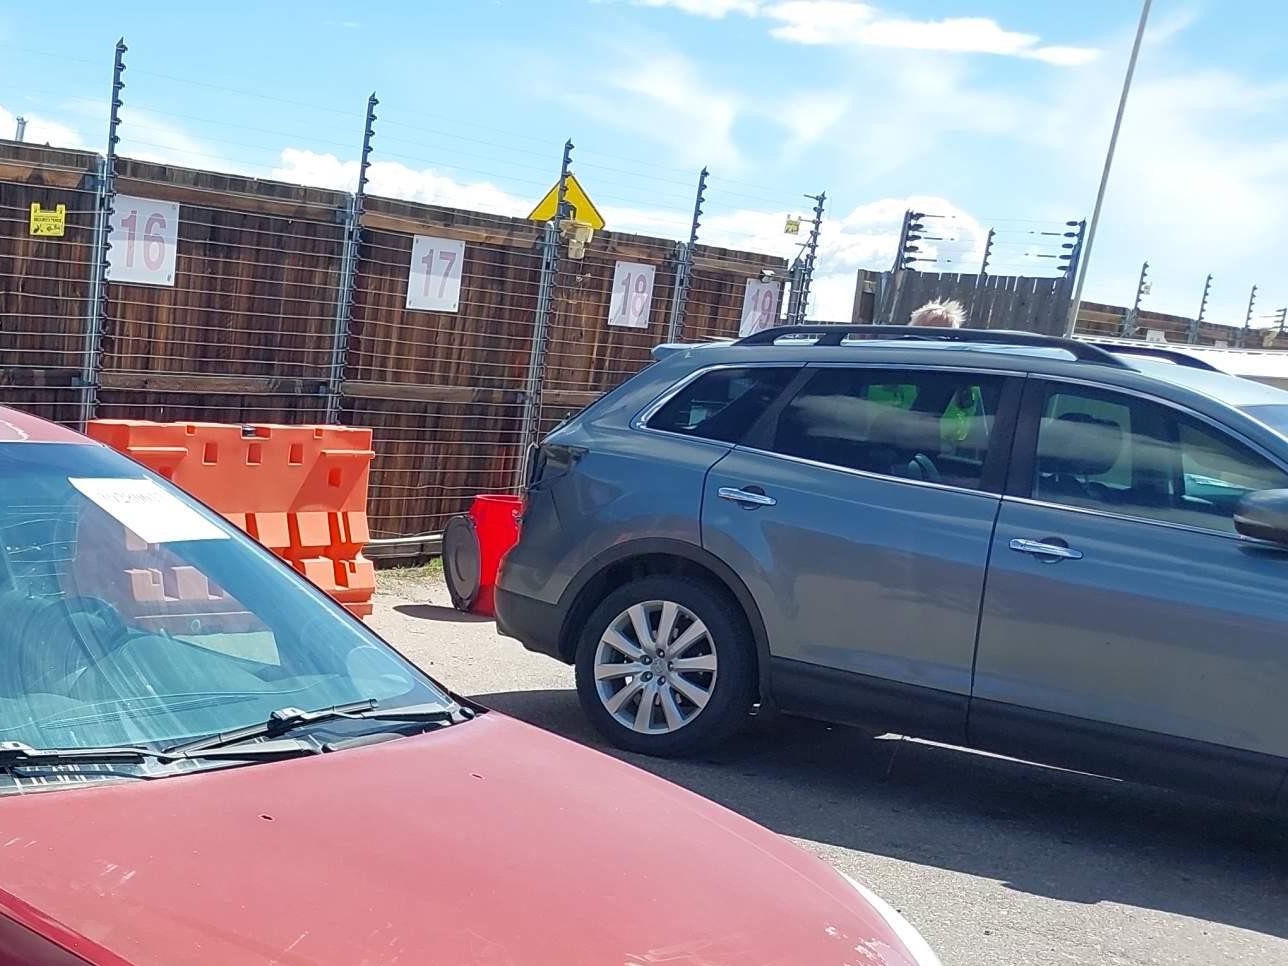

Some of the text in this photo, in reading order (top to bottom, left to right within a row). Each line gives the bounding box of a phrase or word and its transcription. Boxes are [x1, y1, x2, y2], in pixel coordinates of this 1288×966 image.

[120, 210, 167, 272] 16
[421, 248, 457, 298] 17
[621, 272, 648, 318] 18
[750, 288, 773, 330] 19
